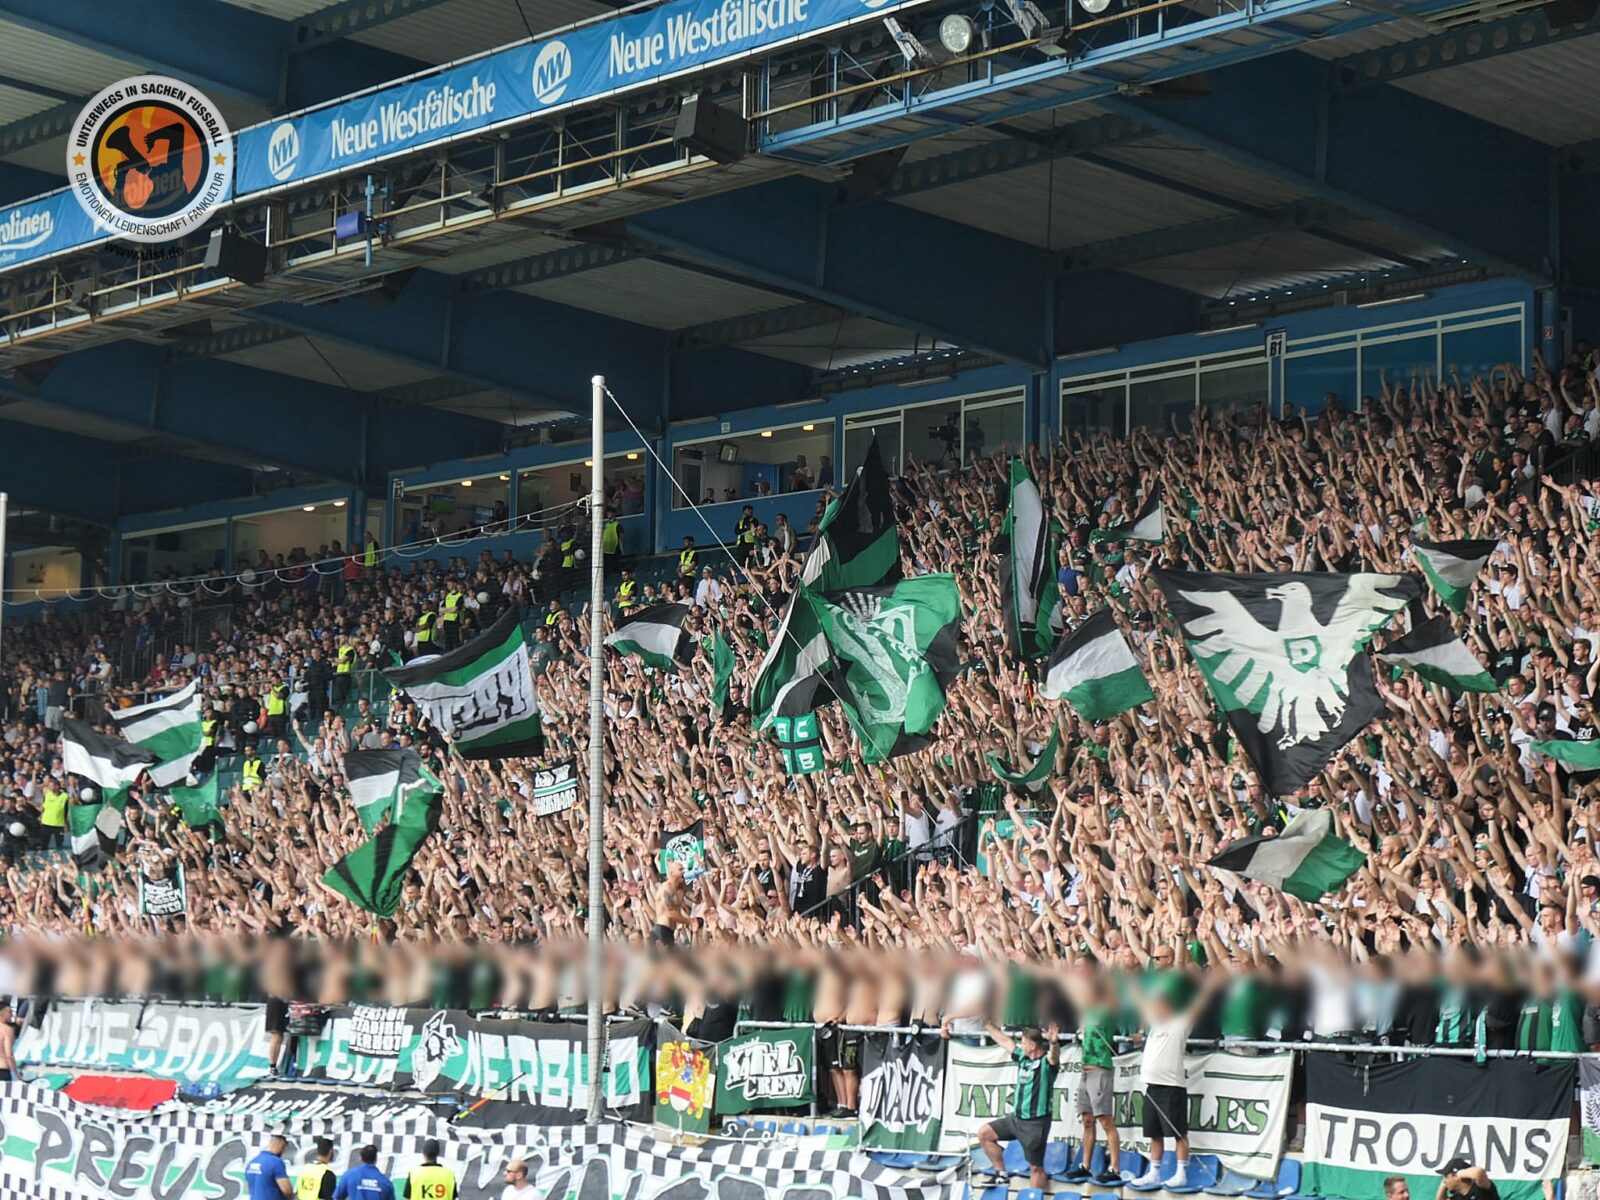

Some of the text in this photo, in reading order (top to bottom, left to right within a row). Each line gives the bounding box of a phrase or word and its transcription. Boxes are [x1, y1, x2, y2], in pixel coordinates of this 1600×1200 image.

[610, 31, 664, 79] Neue
[331, 76, 496, 159] Neue Westfälische
[1271, 340, 1283, 356] B1
[746, 1075, 805, 1098] CREW
[1319, 1113, 1551, 1174] TROJANS
[421, 1184, 446, 1199] K9
